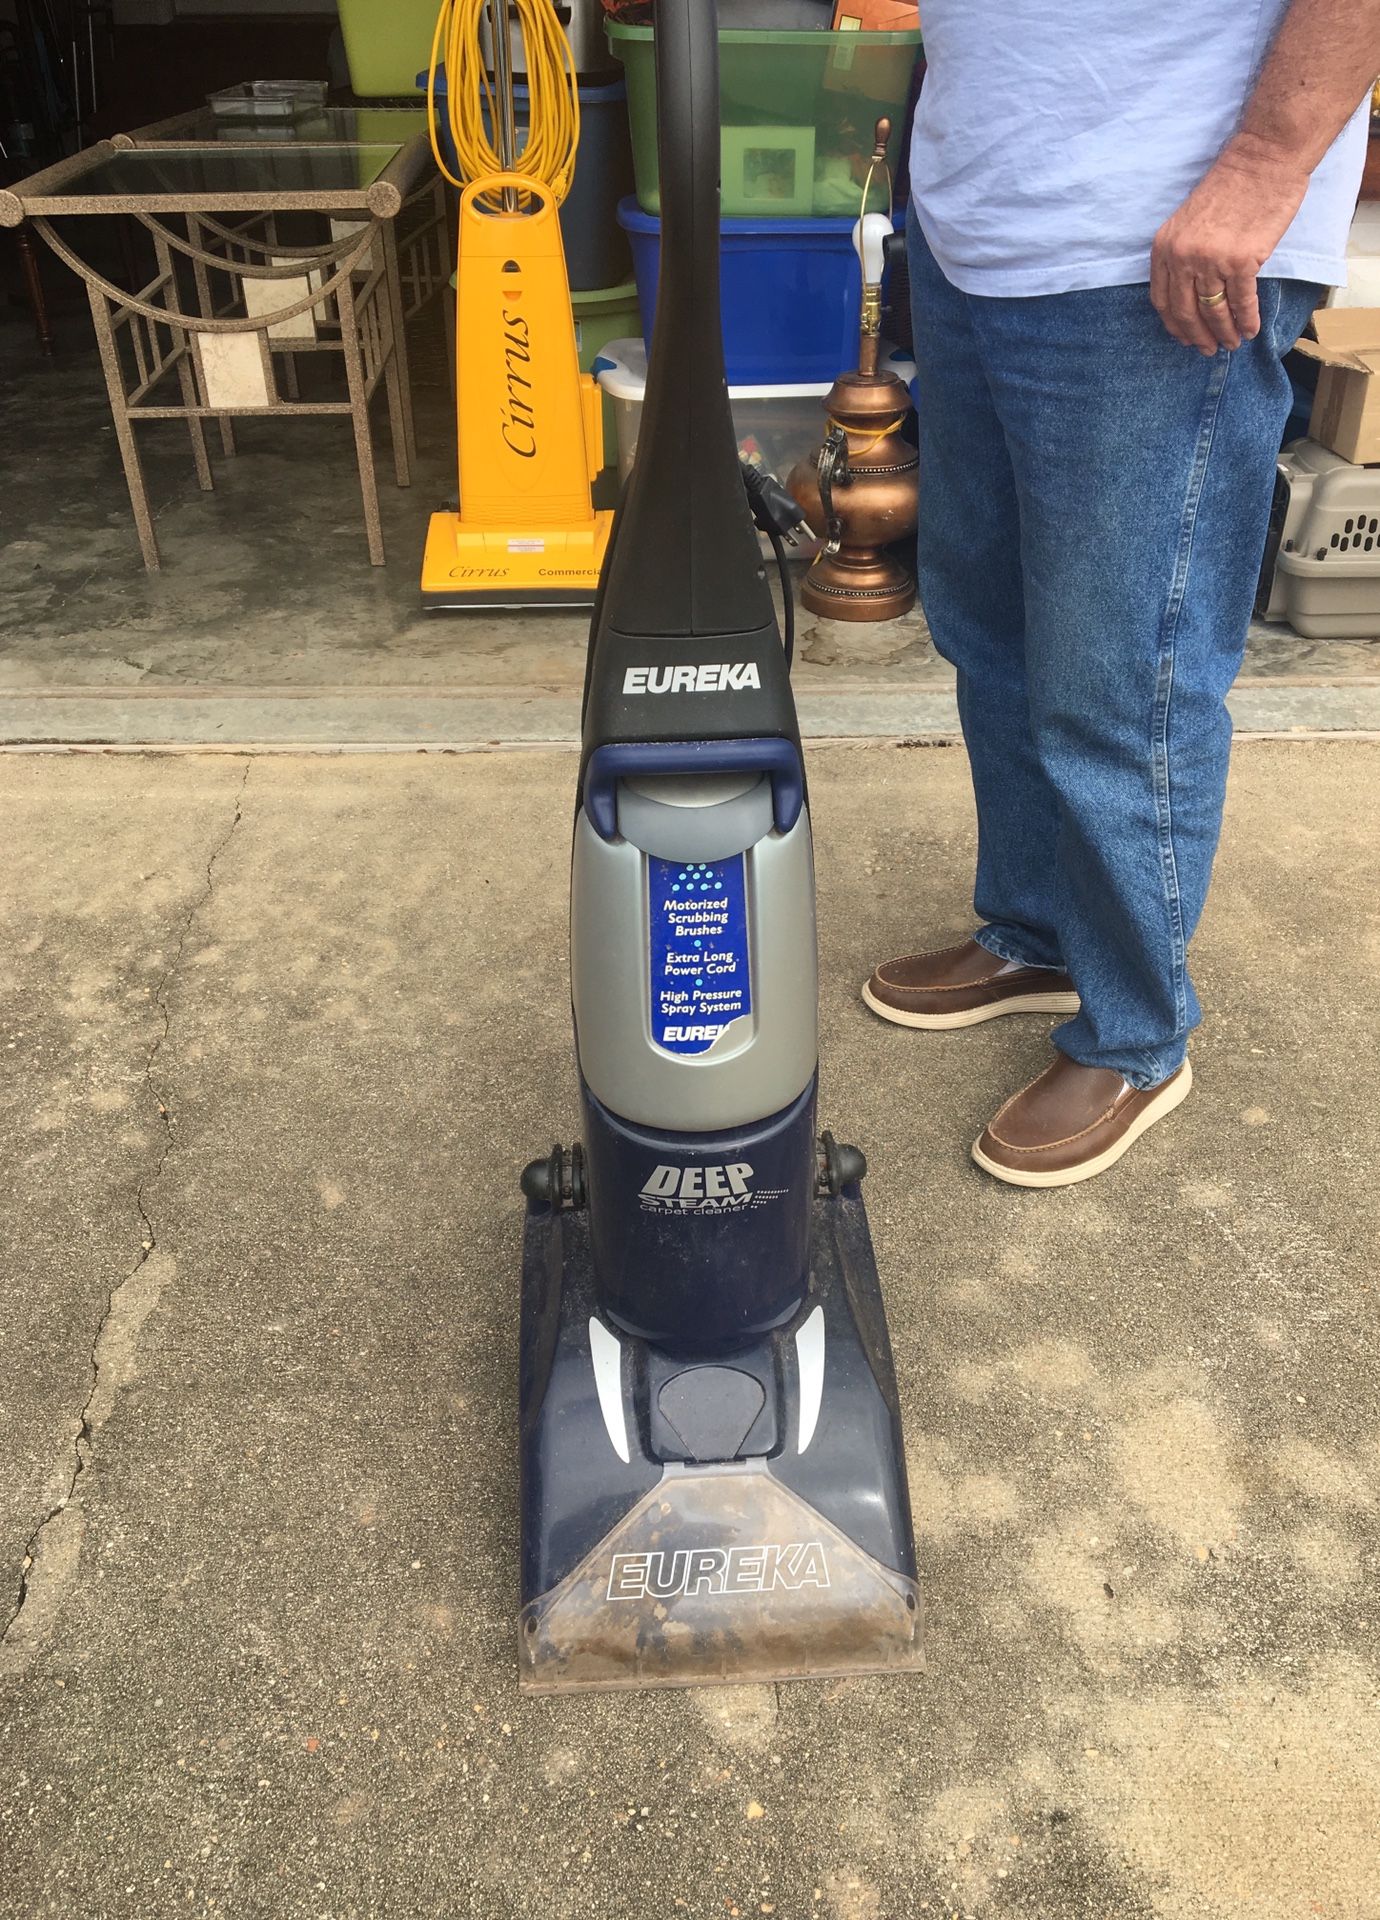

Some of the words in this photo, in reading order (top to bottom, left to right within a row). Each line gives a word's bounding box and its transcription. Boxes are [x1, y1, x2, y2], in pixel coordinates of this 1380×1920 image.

[501, 310, 536, 458] Cirrus
[448, 566, 510, 578] Cirrus
[622, 662, 761, 695] EUREKA
[663, 898, 729, 911] Motorized
[668, 911, 729, 924] Scrubbing
[675, 924, 723, 936] Brushes
[666, 951, 700, 963] Extra
[703, 951, 734, 963] Long
[664, 963, 703, 976] Power
[706, 961, 737, 974] Cord
[660, 990, 689, 1004] High
[692, 989, 742, 1000] Pressure
[661, 1003, 696, 1016] Spray
[699, 1001, 741, 1015] System
[640, 1162, 754, 1198] DEEP
[638, 1192, 753, 1209] STEAM
[639, 1204, 689, 1215] carpet
[693, 1203, 748, 1215] cleaner
[606, 1543, 831, 1601] EUREKA
